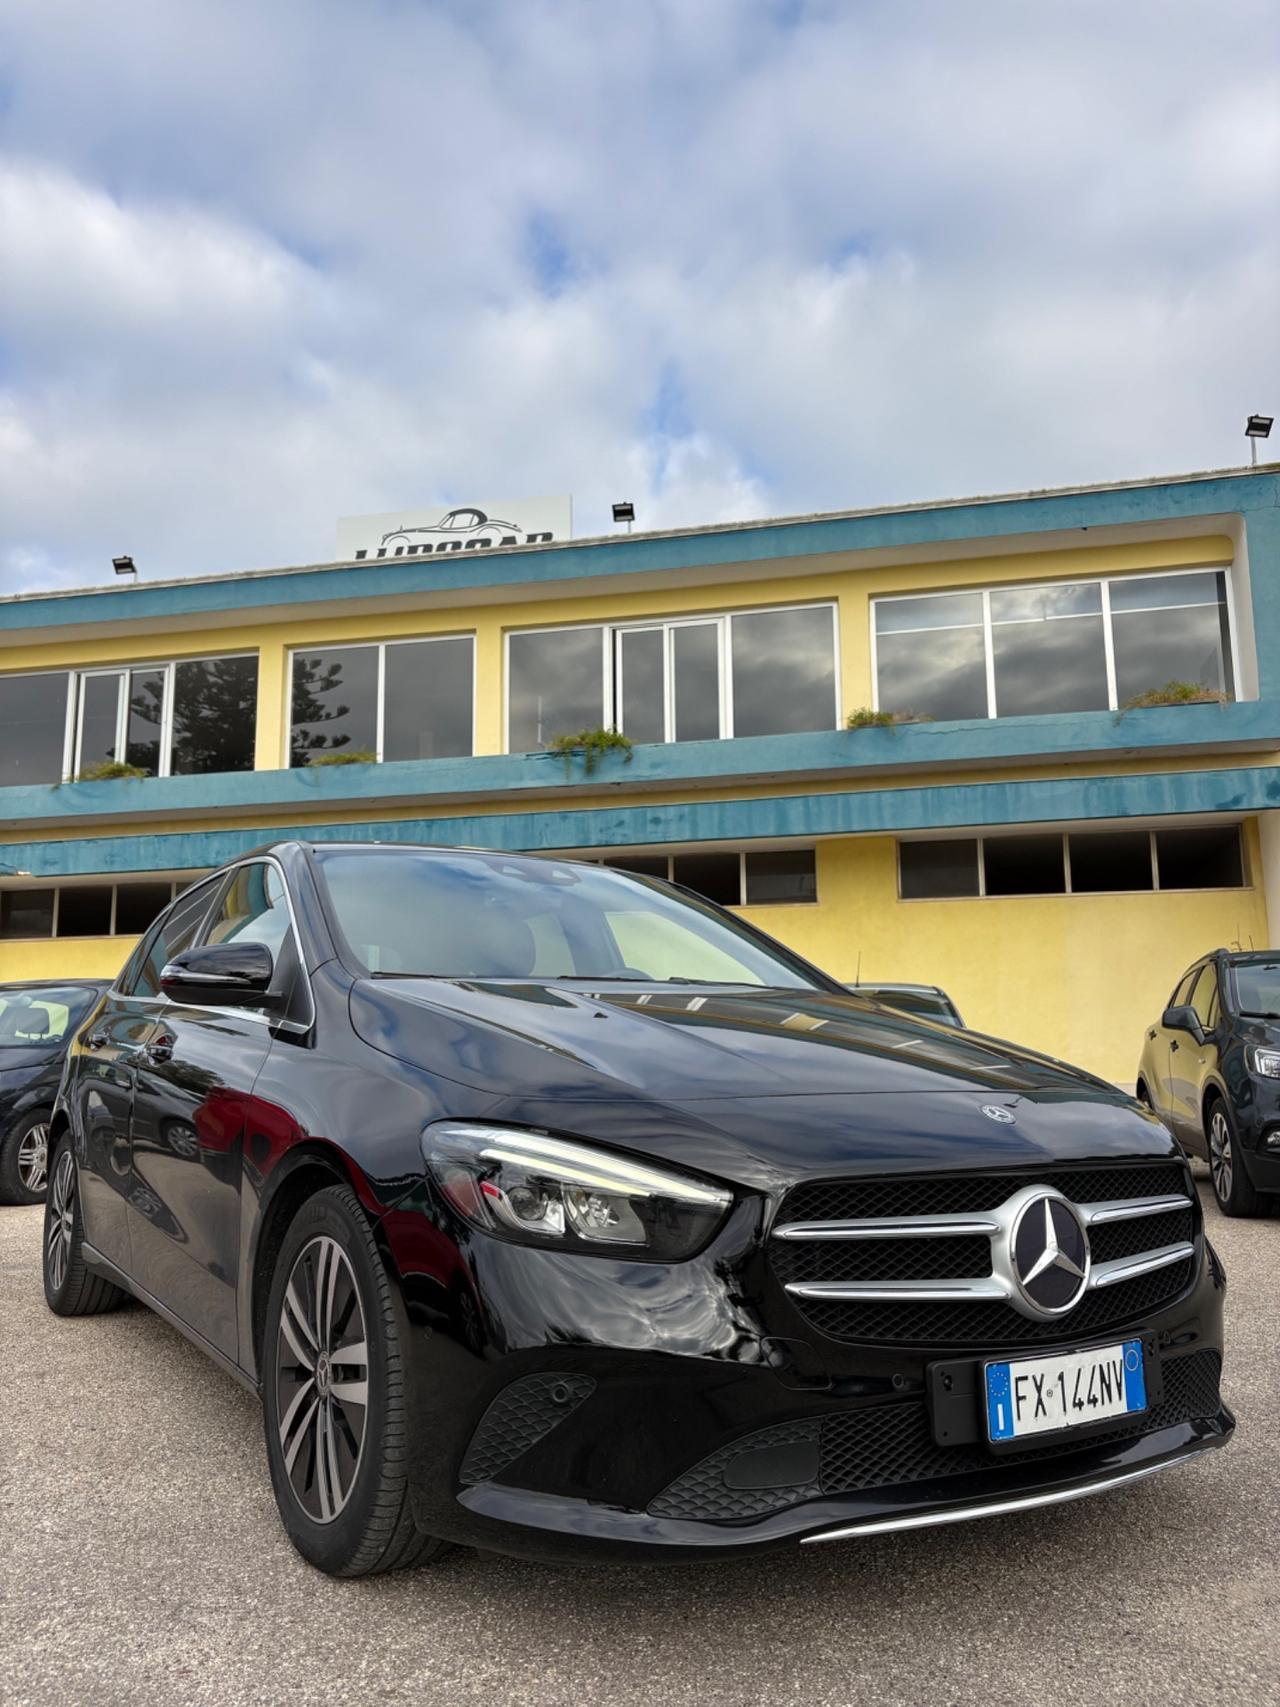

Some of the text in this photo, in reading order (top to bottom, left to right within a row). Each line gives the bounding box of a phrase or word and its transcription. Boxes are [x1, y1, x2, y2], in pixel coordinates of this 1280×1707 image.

[1015, 1359, 1123, 1421] FX 144NV
[997, 1404, 1005, 1430] I
